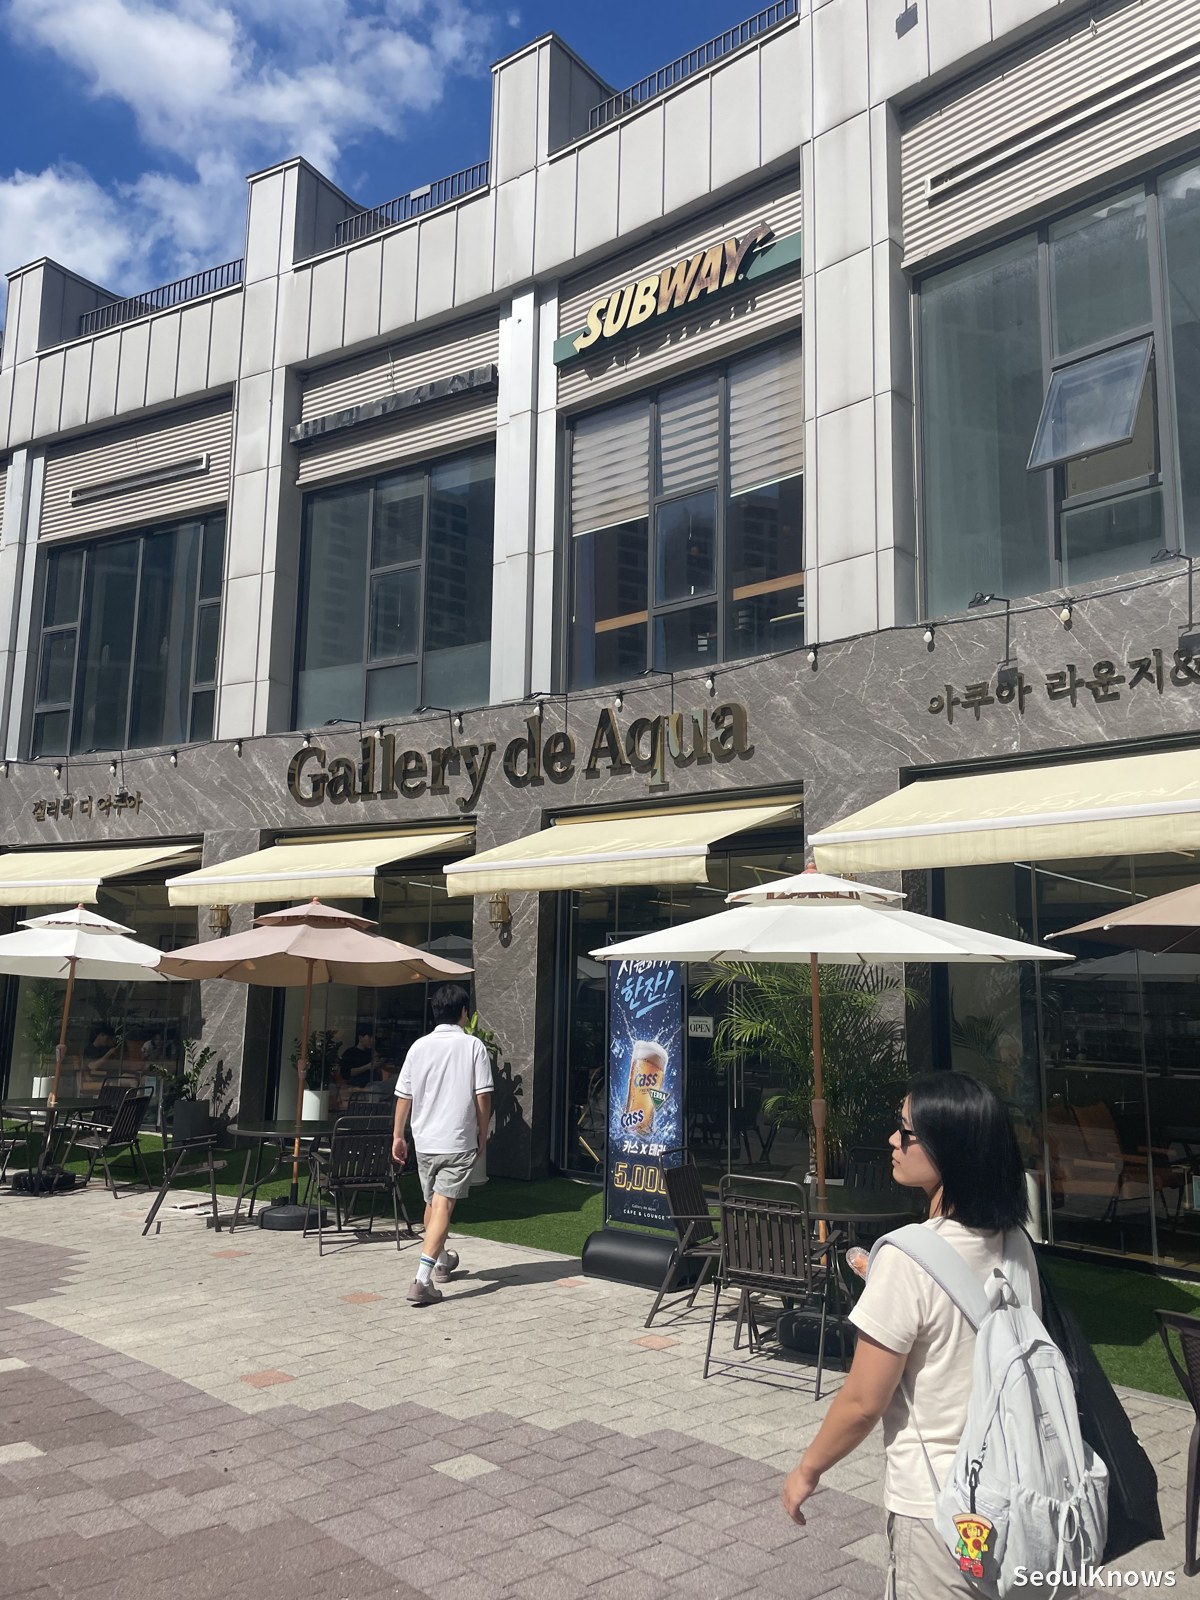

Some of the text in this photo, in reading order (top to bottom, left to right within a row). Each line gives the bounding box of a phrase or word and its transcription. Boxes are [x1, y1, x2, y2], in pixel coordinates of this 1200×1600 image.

[927, 647, 1200, 725] 아쿠아 라운지&
[287, 702, 754, 811] Gallery de Aqua
[80, 795, 93, 819] 디
[621, 970, 674, 1010] 한잔!
[690, 1024, 711, 1033] OPEN
[622, 1140, 638, 1154] 카스
